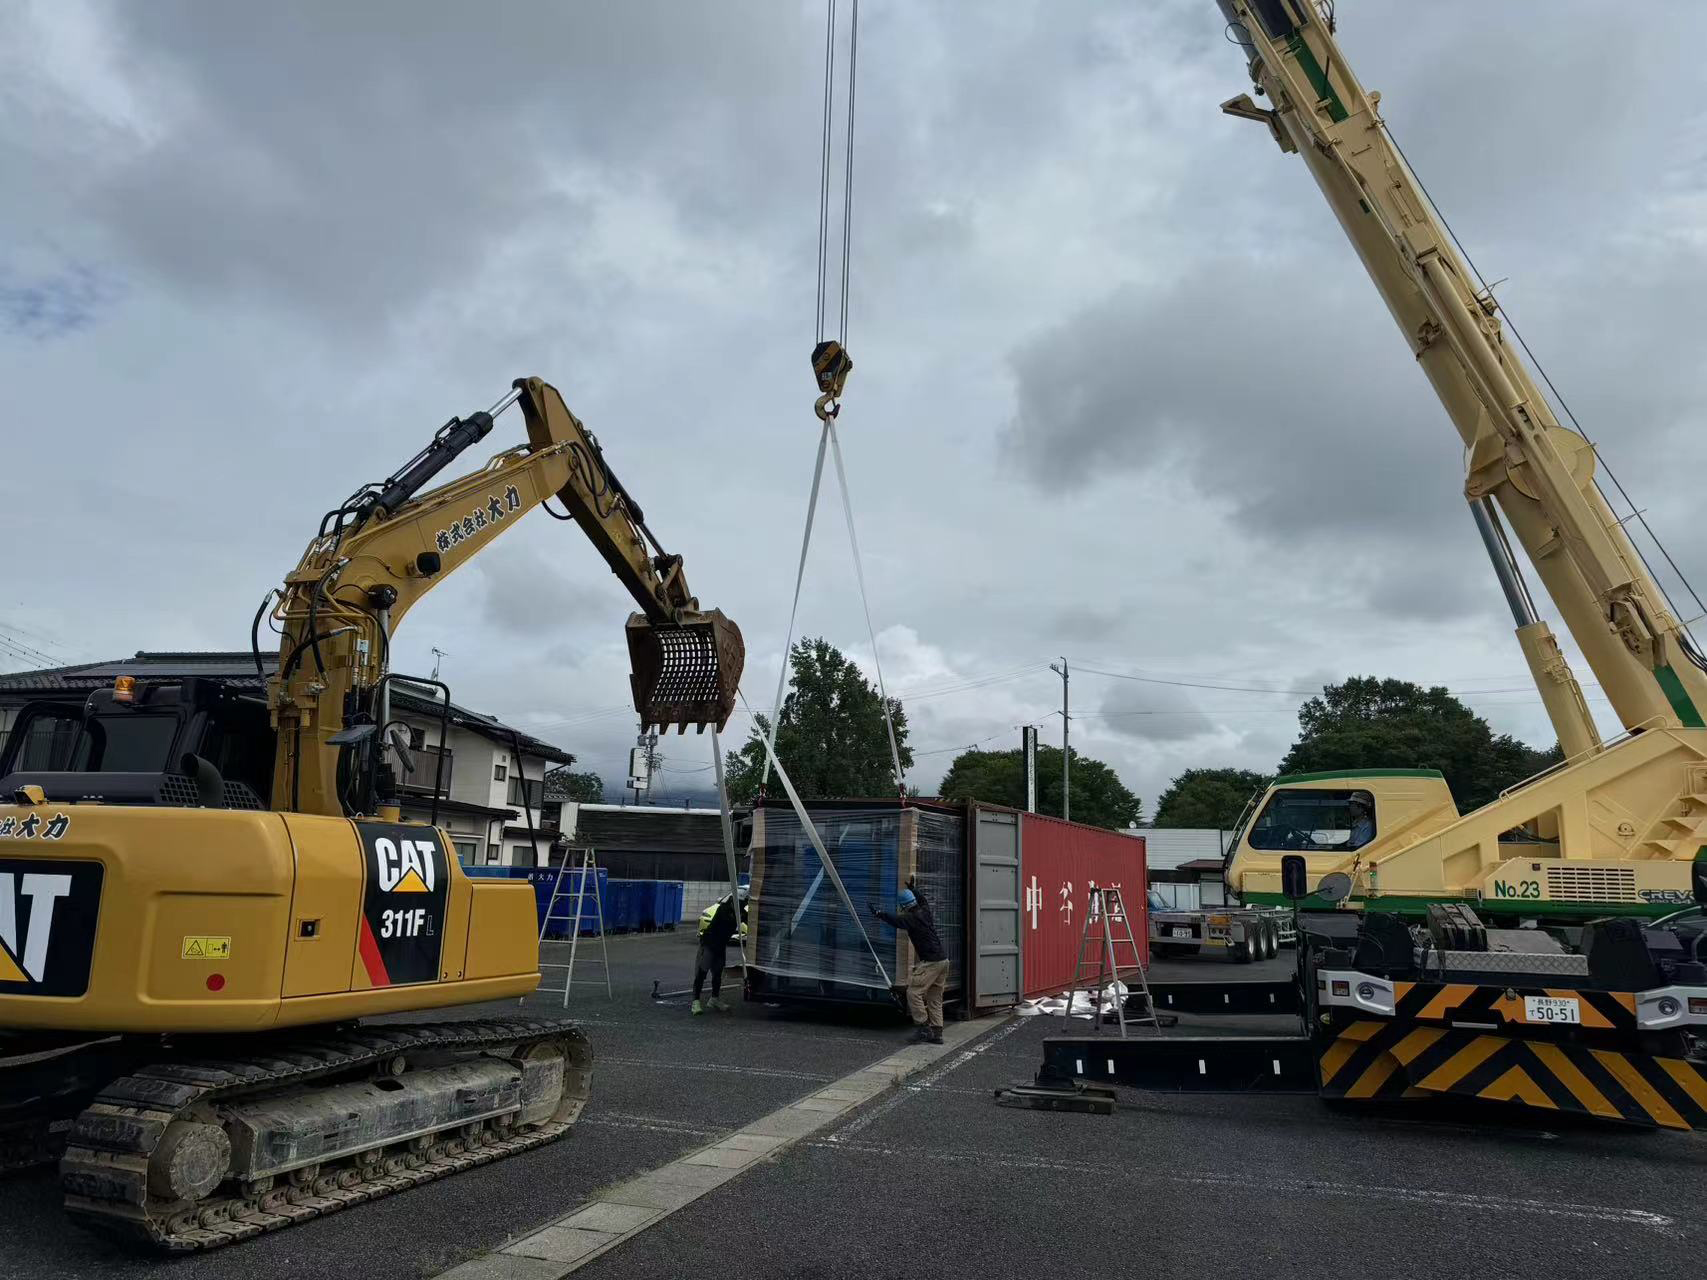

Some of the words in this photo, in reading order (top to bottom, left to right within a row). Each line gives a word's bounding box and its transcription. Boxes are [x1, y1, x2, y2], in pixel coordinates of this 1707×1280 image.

[435, 485, 521, 553] 株式会社大力
[375, 838, 436, 893] CAT
[1495, 880, 1540, 898] No.23
[381, 909, 425, 938] 311F
[1537, 1007, 1575, 1021] 50-51
